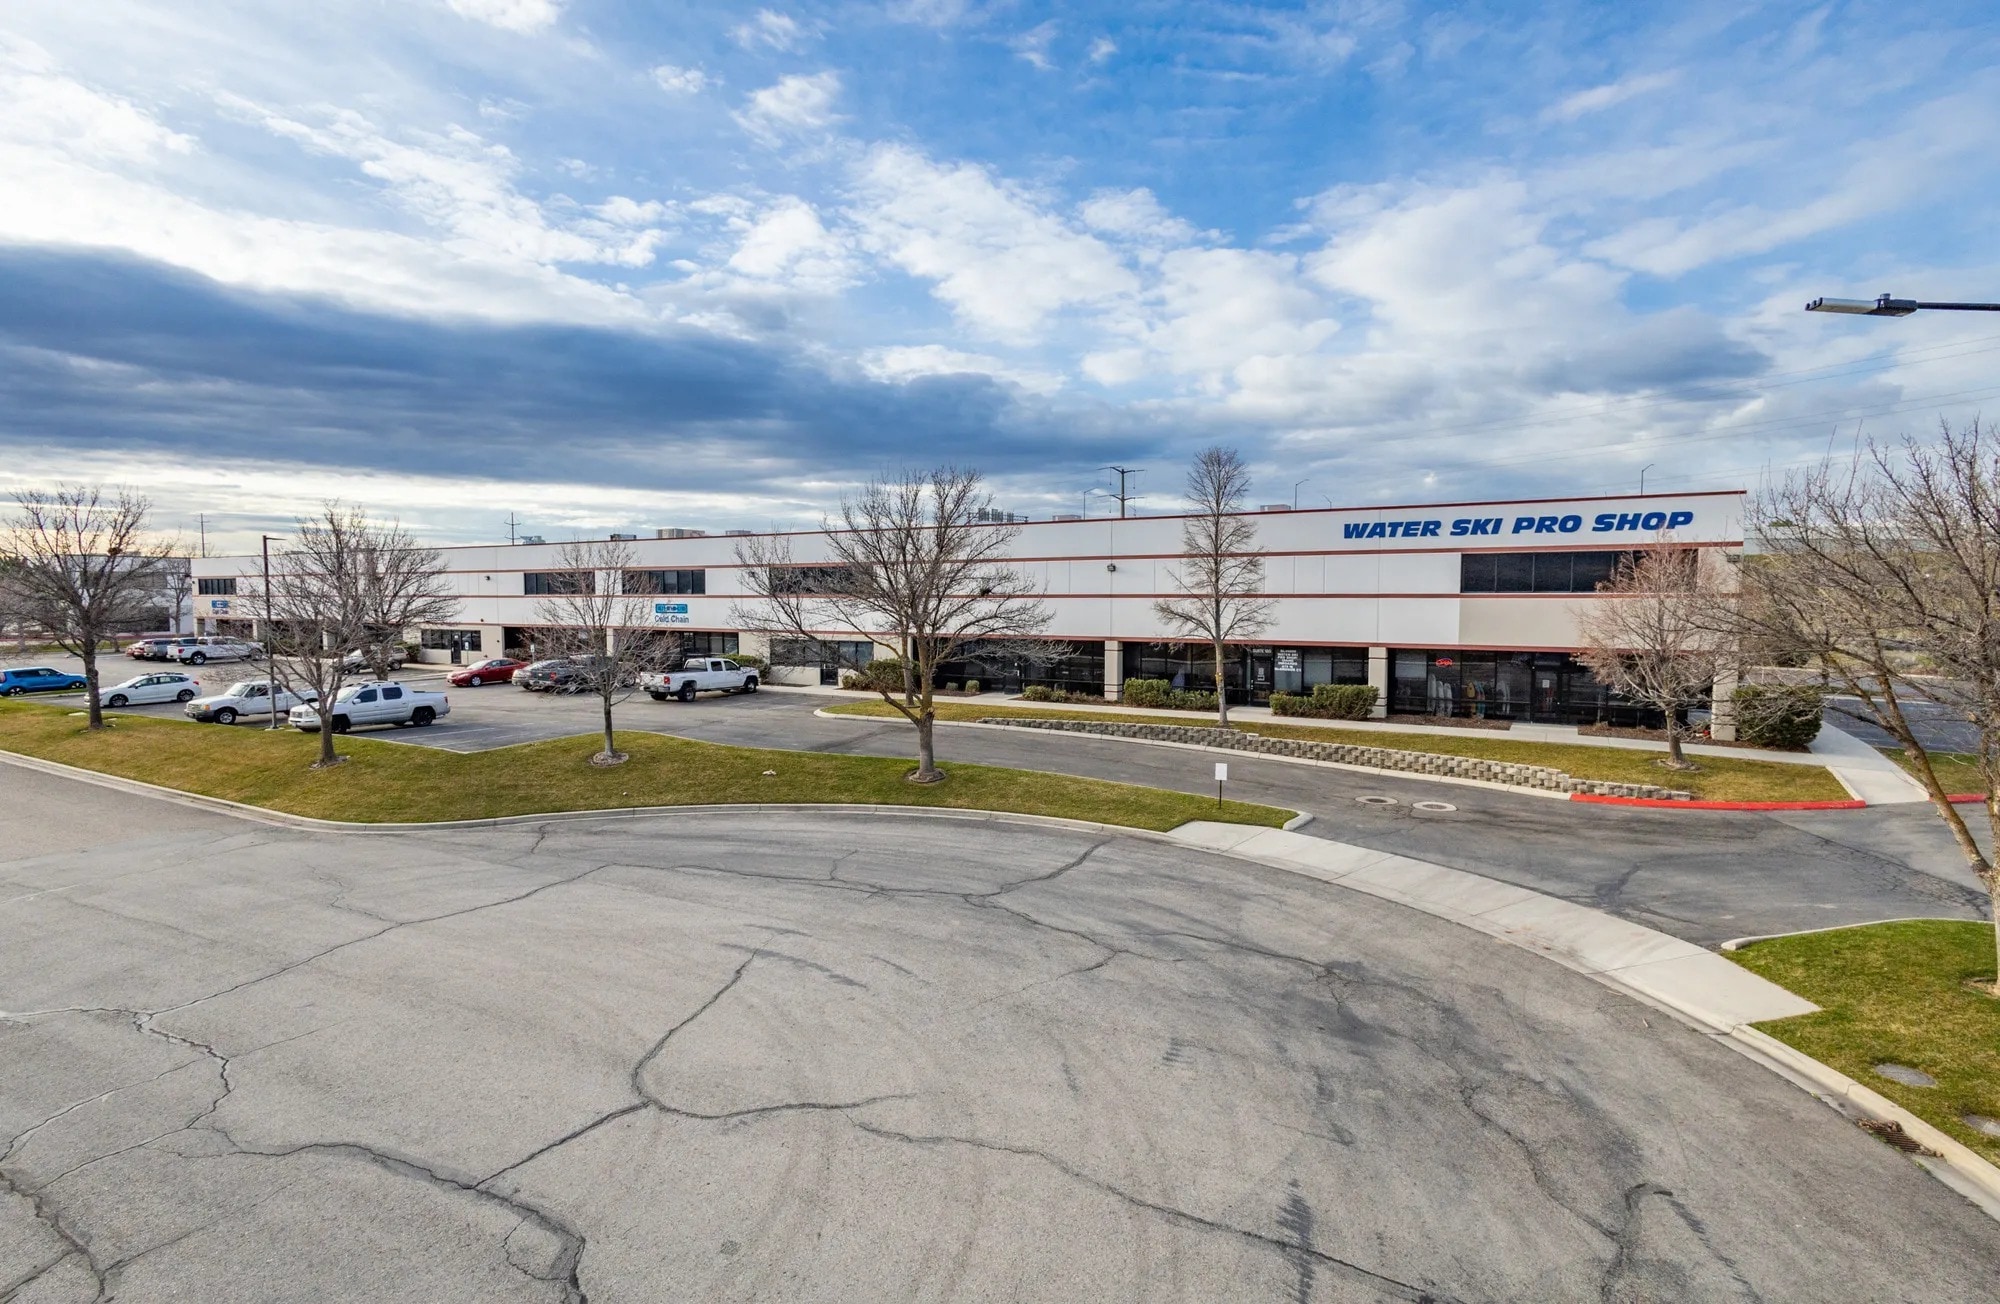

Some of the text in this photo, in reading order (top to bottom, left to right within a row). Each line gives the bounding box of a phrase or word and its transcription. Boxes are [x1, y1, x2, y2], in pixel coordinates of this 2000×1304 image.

[1344, 511, 1694, 539] WATER SKI PRO SHOP
[670, 615, 690, 624] Chain
